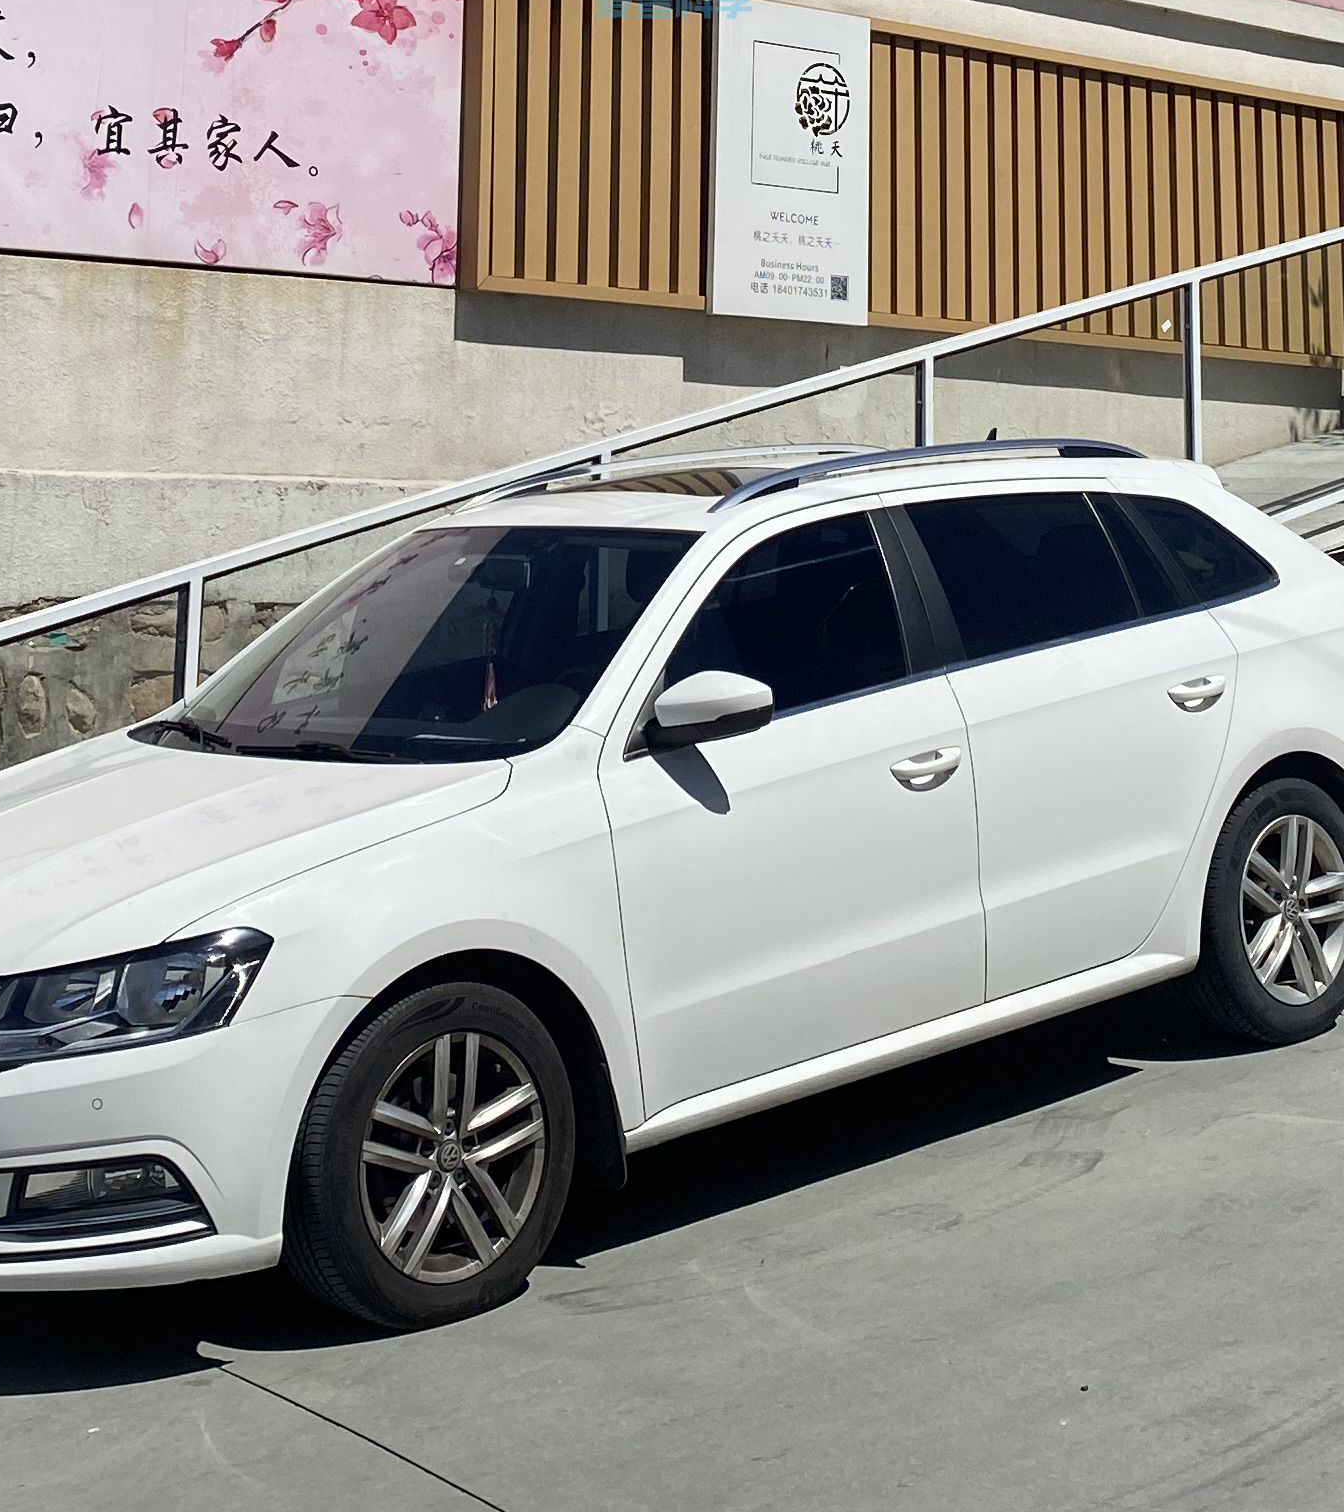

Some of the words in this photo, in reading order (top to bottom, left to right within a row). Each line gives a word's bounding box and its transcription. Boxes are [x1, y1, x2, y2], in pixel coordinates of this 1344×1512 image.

[770, 211, 819, 226] WELCOME
[760, 258, 794, 271] Business
[795, 261, 819, 273] Hours
[750, 282, 769, 294] 电话
